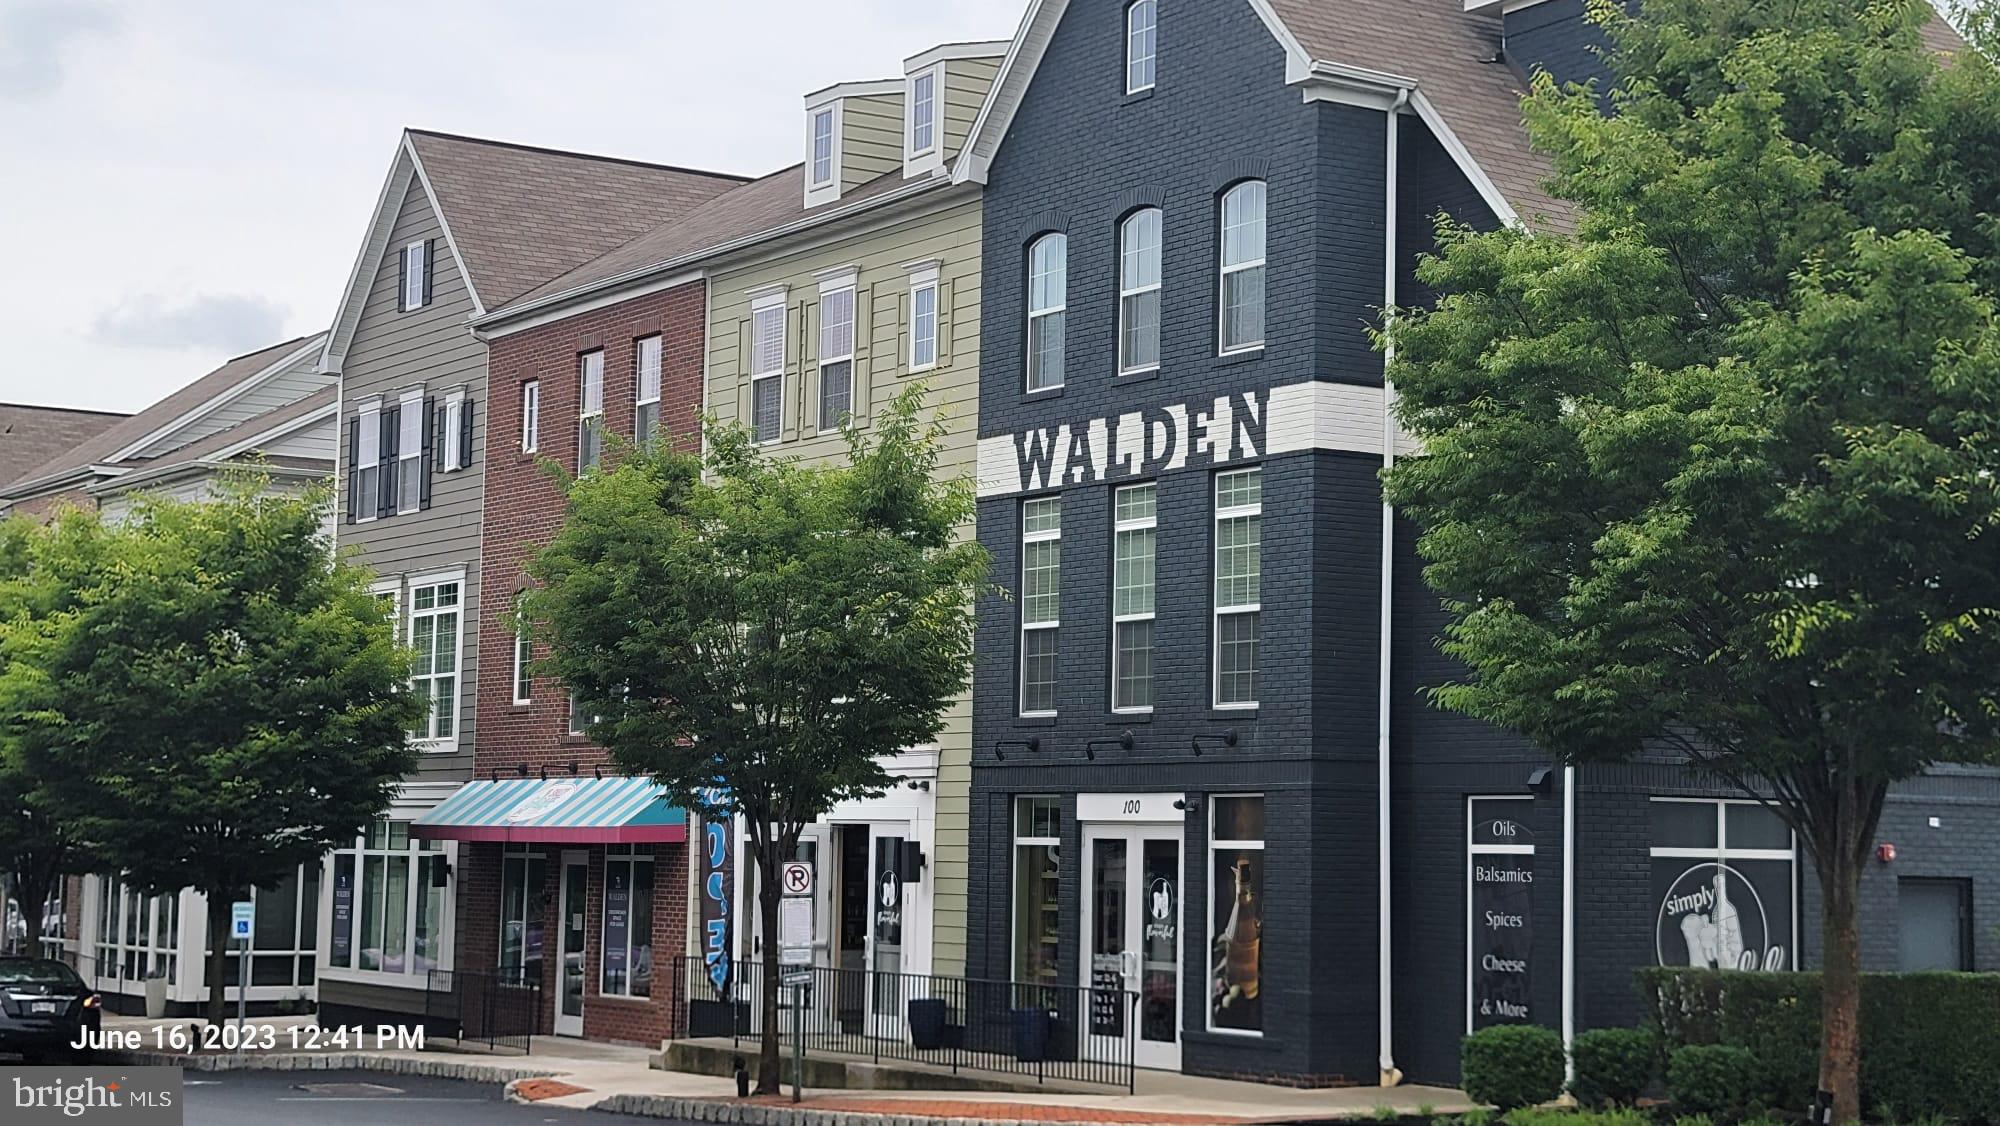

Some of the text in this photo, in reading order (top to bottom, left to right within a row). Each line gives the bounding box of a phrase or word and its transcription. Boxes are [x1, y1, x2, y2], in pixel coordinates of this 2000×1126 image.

[1013, 389, 1271, 491] WALDEN
[1123, 799, 1141, 814] 100
[1492, 820, 1516, 837] Oils
[1476, 866, 1533, 883] Balsamics
[1666, 885, 1715, 915] simply
[1485, 910, 1523, 930] Spices
[1482, 954, 1526, 972] Cheese
[1480, 999, 1528, 1018] & More
